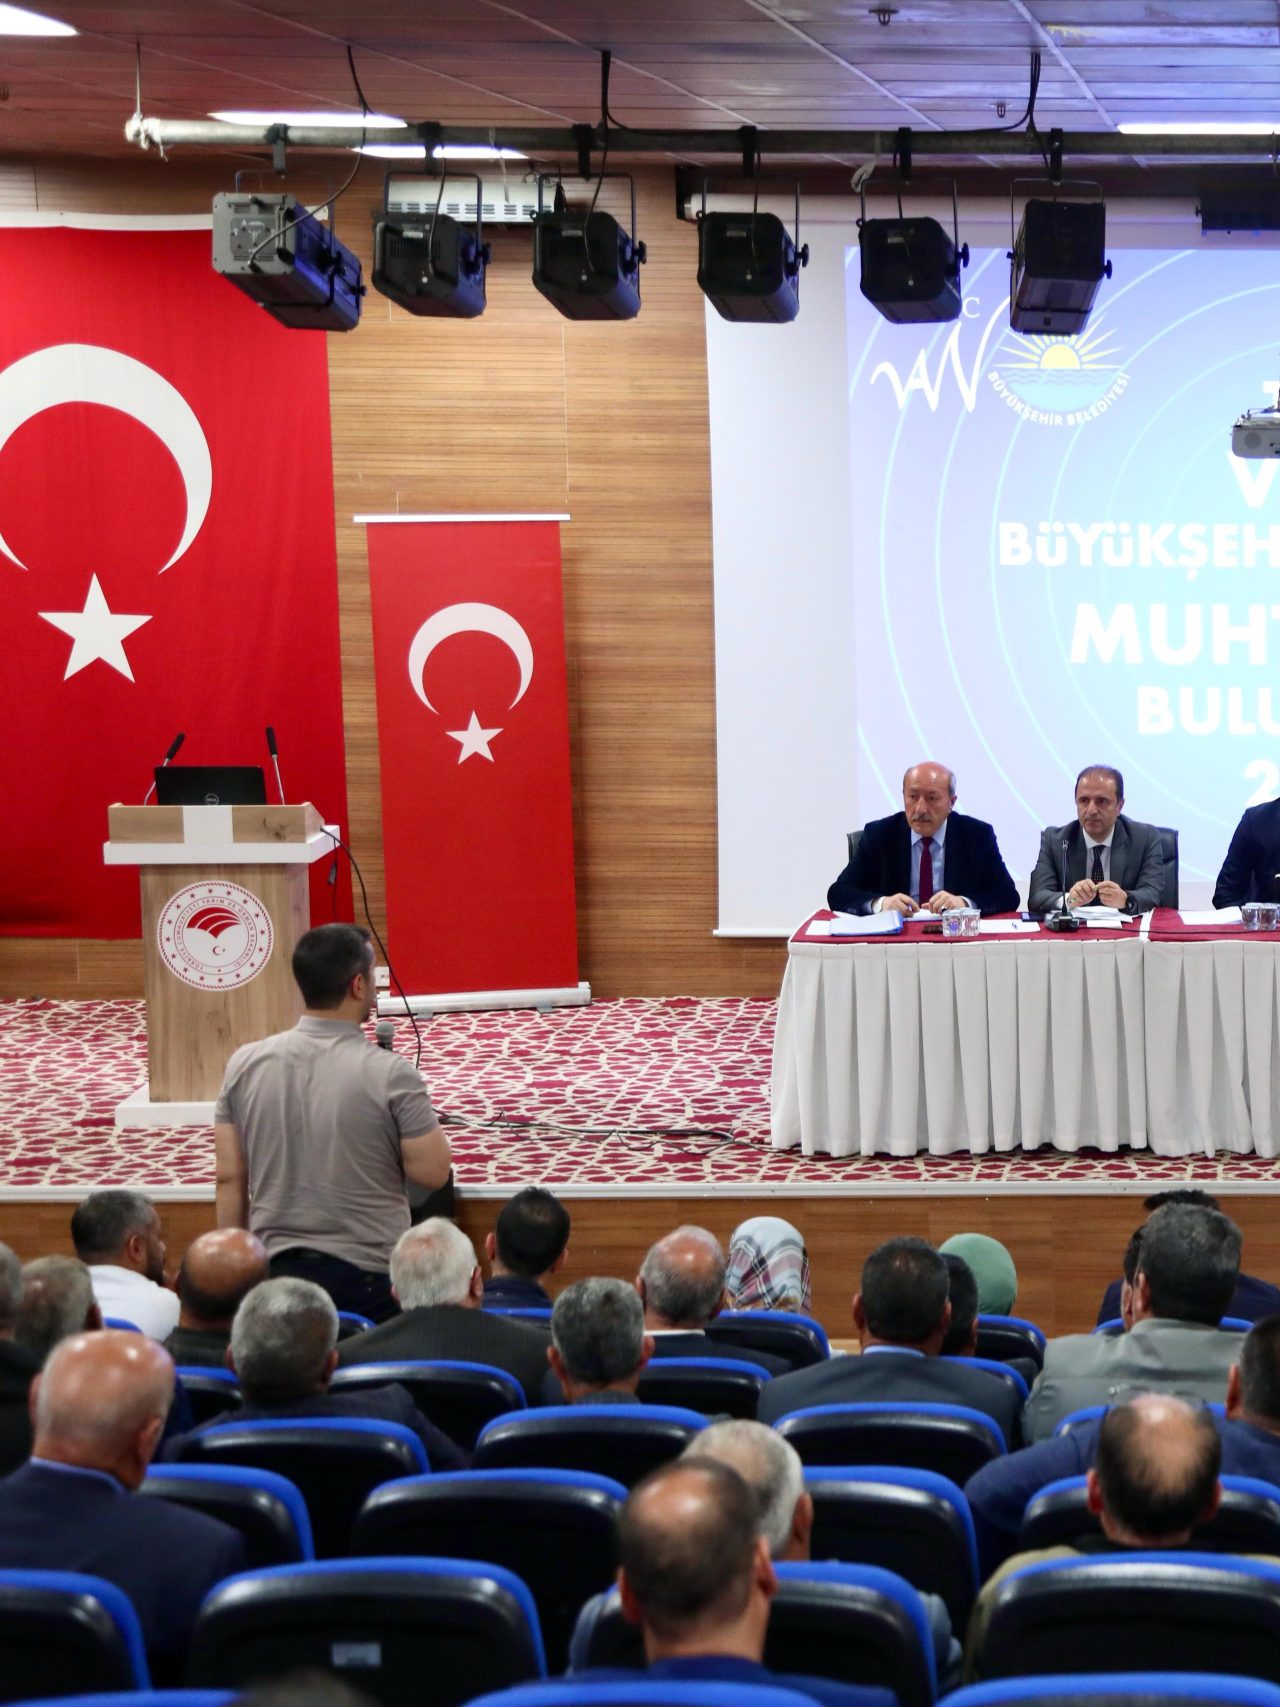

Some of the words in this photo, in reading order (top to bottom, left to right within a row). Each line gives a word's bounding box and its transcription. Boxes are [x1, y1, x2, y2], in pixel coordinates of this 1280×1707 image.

[870, 296, 1011, 413] VAN
[988, 371, 1063, 426] BÜYÜKŞEHİR
[1067, 371, 1131, 426] BELEDİYESİ
